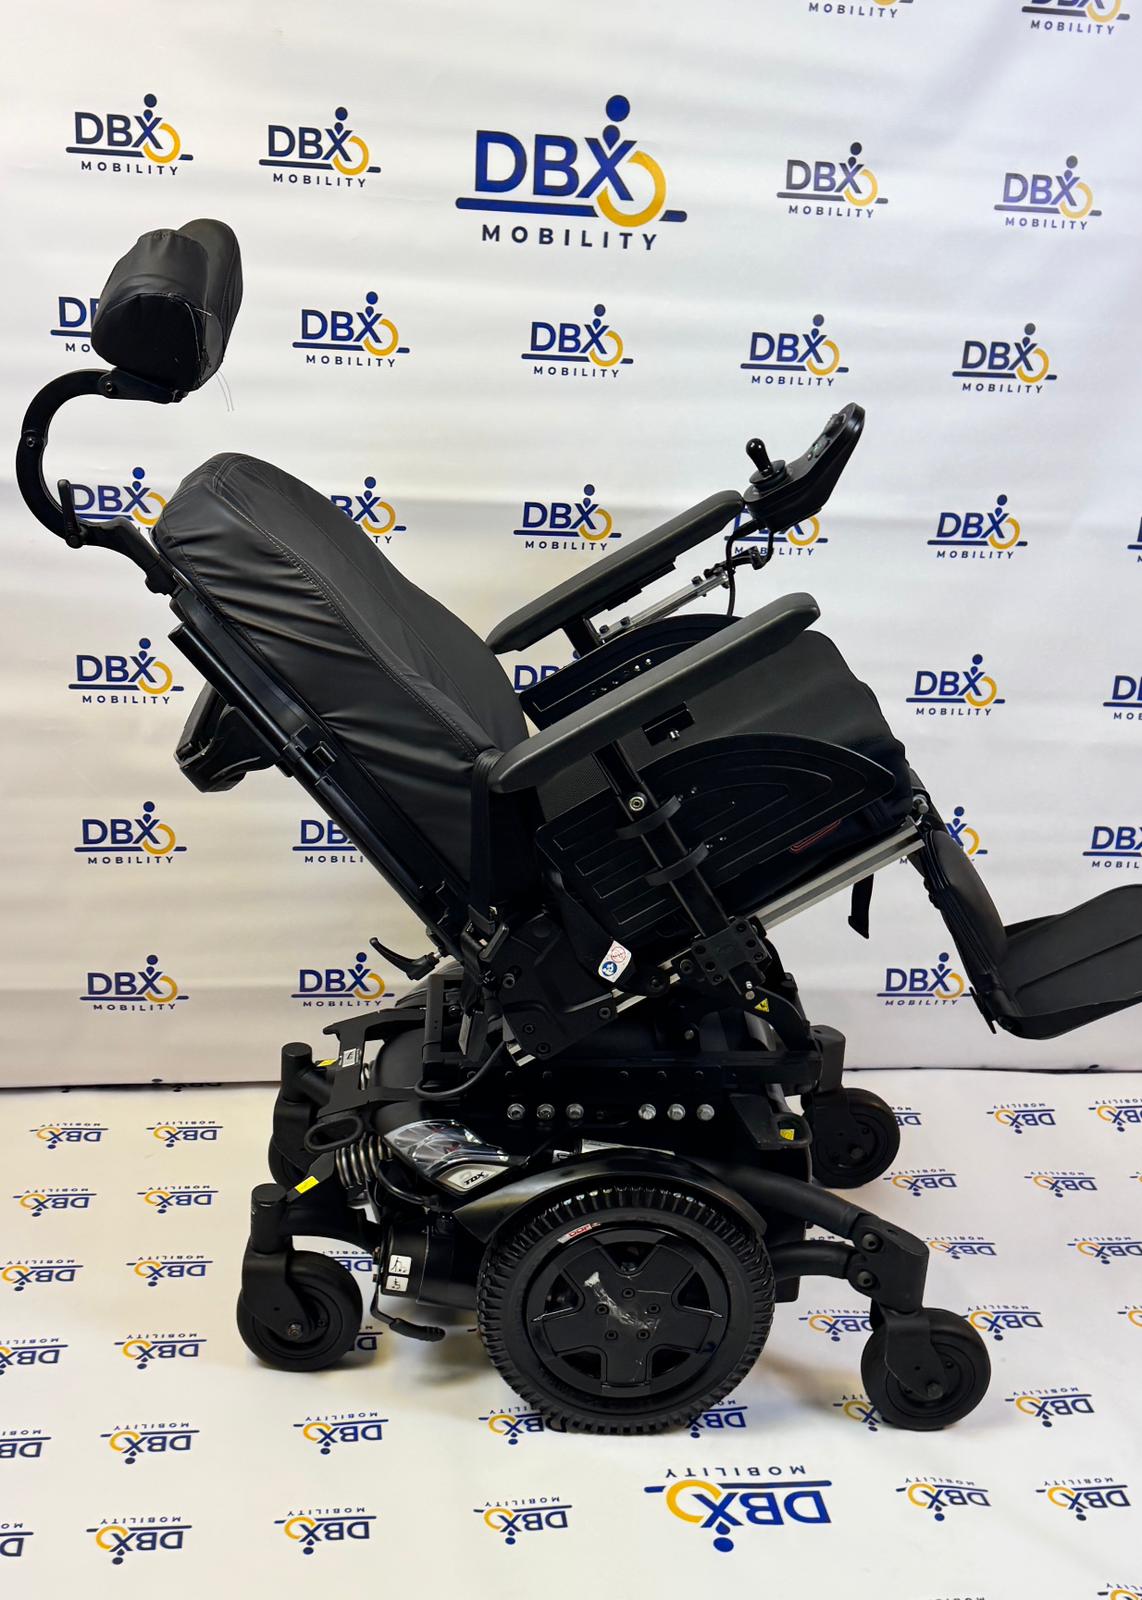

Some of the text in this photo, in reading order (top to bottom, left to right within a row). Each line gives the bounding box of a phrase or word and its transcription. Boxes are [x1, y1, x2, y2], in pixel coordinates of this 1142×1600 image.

[808, 4, 899, 18] MOBILITY
[1030, 20, 1116, 35] MOBILITY
[74, 111, 163, 149] DBX
[268, 125, 352, 162] DBX
[81, 161, 179, 175] MOBILITY
[475, 130, 637, 200] DBX
[273, 173, 367, 187] MOBILITY
[785, 159, 866, 194] DBX
[1003, 172, 1081, 206] DBX
[788, 205, 875, 219] MOBILITY
[1005, 217, 1089, 230] MOBILITY
[483, 224, 657, 250] MOBILITY
[301, 309, 382, 343] DBX
[530, 321, 610, 354] DBX
[750, 331, 827, 364] DBX
[305, 355, 397, 367] MOBILITY
[961, 340, 1038, 371] DBX
[533, 365, 620, 378] MOBILITY
[751, 375, 835, 387] MOBILITY
[962, 382, 1043, 394] MOBILITY
[72, 484, 151, 513] DBX
[331, 495, 381, 522] BX
[522, 502, 598, 529] DBX
[937, 512, 1008, 538] DBX
[525, 541, 607, 550] MOBILITY
[735, 547, 814, 556] MBLITY
[937, 550, 1014, 559] MOBILITY
[76, 654, 156, 683] DBX
[914, 671, 985, 696] DBX
[82, 694, 170, 704] MOBILITY
[916, 707, 992, 716] MOBILITY
[82, 818, 160, 844] DBX
[301, 820, 350, 844] DB
[1091, 826, 1142, 851] DB
[88, 856, 174, 864] MOBILITY
[305, 855, 364, 864] MOBILI
[1092, 861, 1140, 870] MOBIL
[87, 972, 162, 995] DBX
[299, 969, 368, 992] DBX
[885, 968, 952, 991] DBX
[93, 1003, 176, 1011] MOBILITY
[1006, 1112, 1056, 1128] DBX
[1107, 1110, 1142, 1124] BX
[48, 1129, 102, 1143] DBX
[164, 1127, 217, 1142] DBX
[464, 1171, 485, 1185] TDX
[902, 1175, 957, 1188] DBX
[1049, 1178, 1098, 1191] DBX
[30, 1195, 89, 1210] DBX
[156, 1193, 213, 1208] DBX
[940, 1244, 997, 1256] DBX
[1087, 1245, 1142, 1257] DBX
[14, 1268, 76, 1284] DBX
[147, 1263, 206, 1279] DBX
[968, 1304, 1029, 1312] MOBILITY
[981, 1315, 1043, 1332] DBX
[127, 1332, 197, 1340] MOBILITY
[137, 1344, 200, 1360] DBX
[1013, 1387, 1079, 1396] MOBILITY
[1028, 1399, 1095, 1417] DBX
[305, 1412, 377, 1421] MOBILITY
[114, 1422, 189, 1431] MOBILITY
[316, 1424, 382, 1443] DBX
[0, 1441, 42, 1458] DB
[122, 1435, 191, 1454] DBX
[666, 1465, 806, 1478] MOBILITY
[905, 1477, 975, 1486] MOBILITY
[1044, 1477, 1114, 1486] MOBILITY
[485, 1496, 560, 1506] MOBILITY
[922, 1489, 991, 1509] DBX
[1060, 1490, 1131, 1510] DBX
[287, 1508, 365, 1516] MOBILITY
[692, 1490, 832, 1528] DBX
[100, 1516, 181, 1525] MOBILITY
[500, 1510, 568, 1532] DBX
[299, 1522, 370, 1542] DBX
[111, 1531, 184, 1552] DBX
